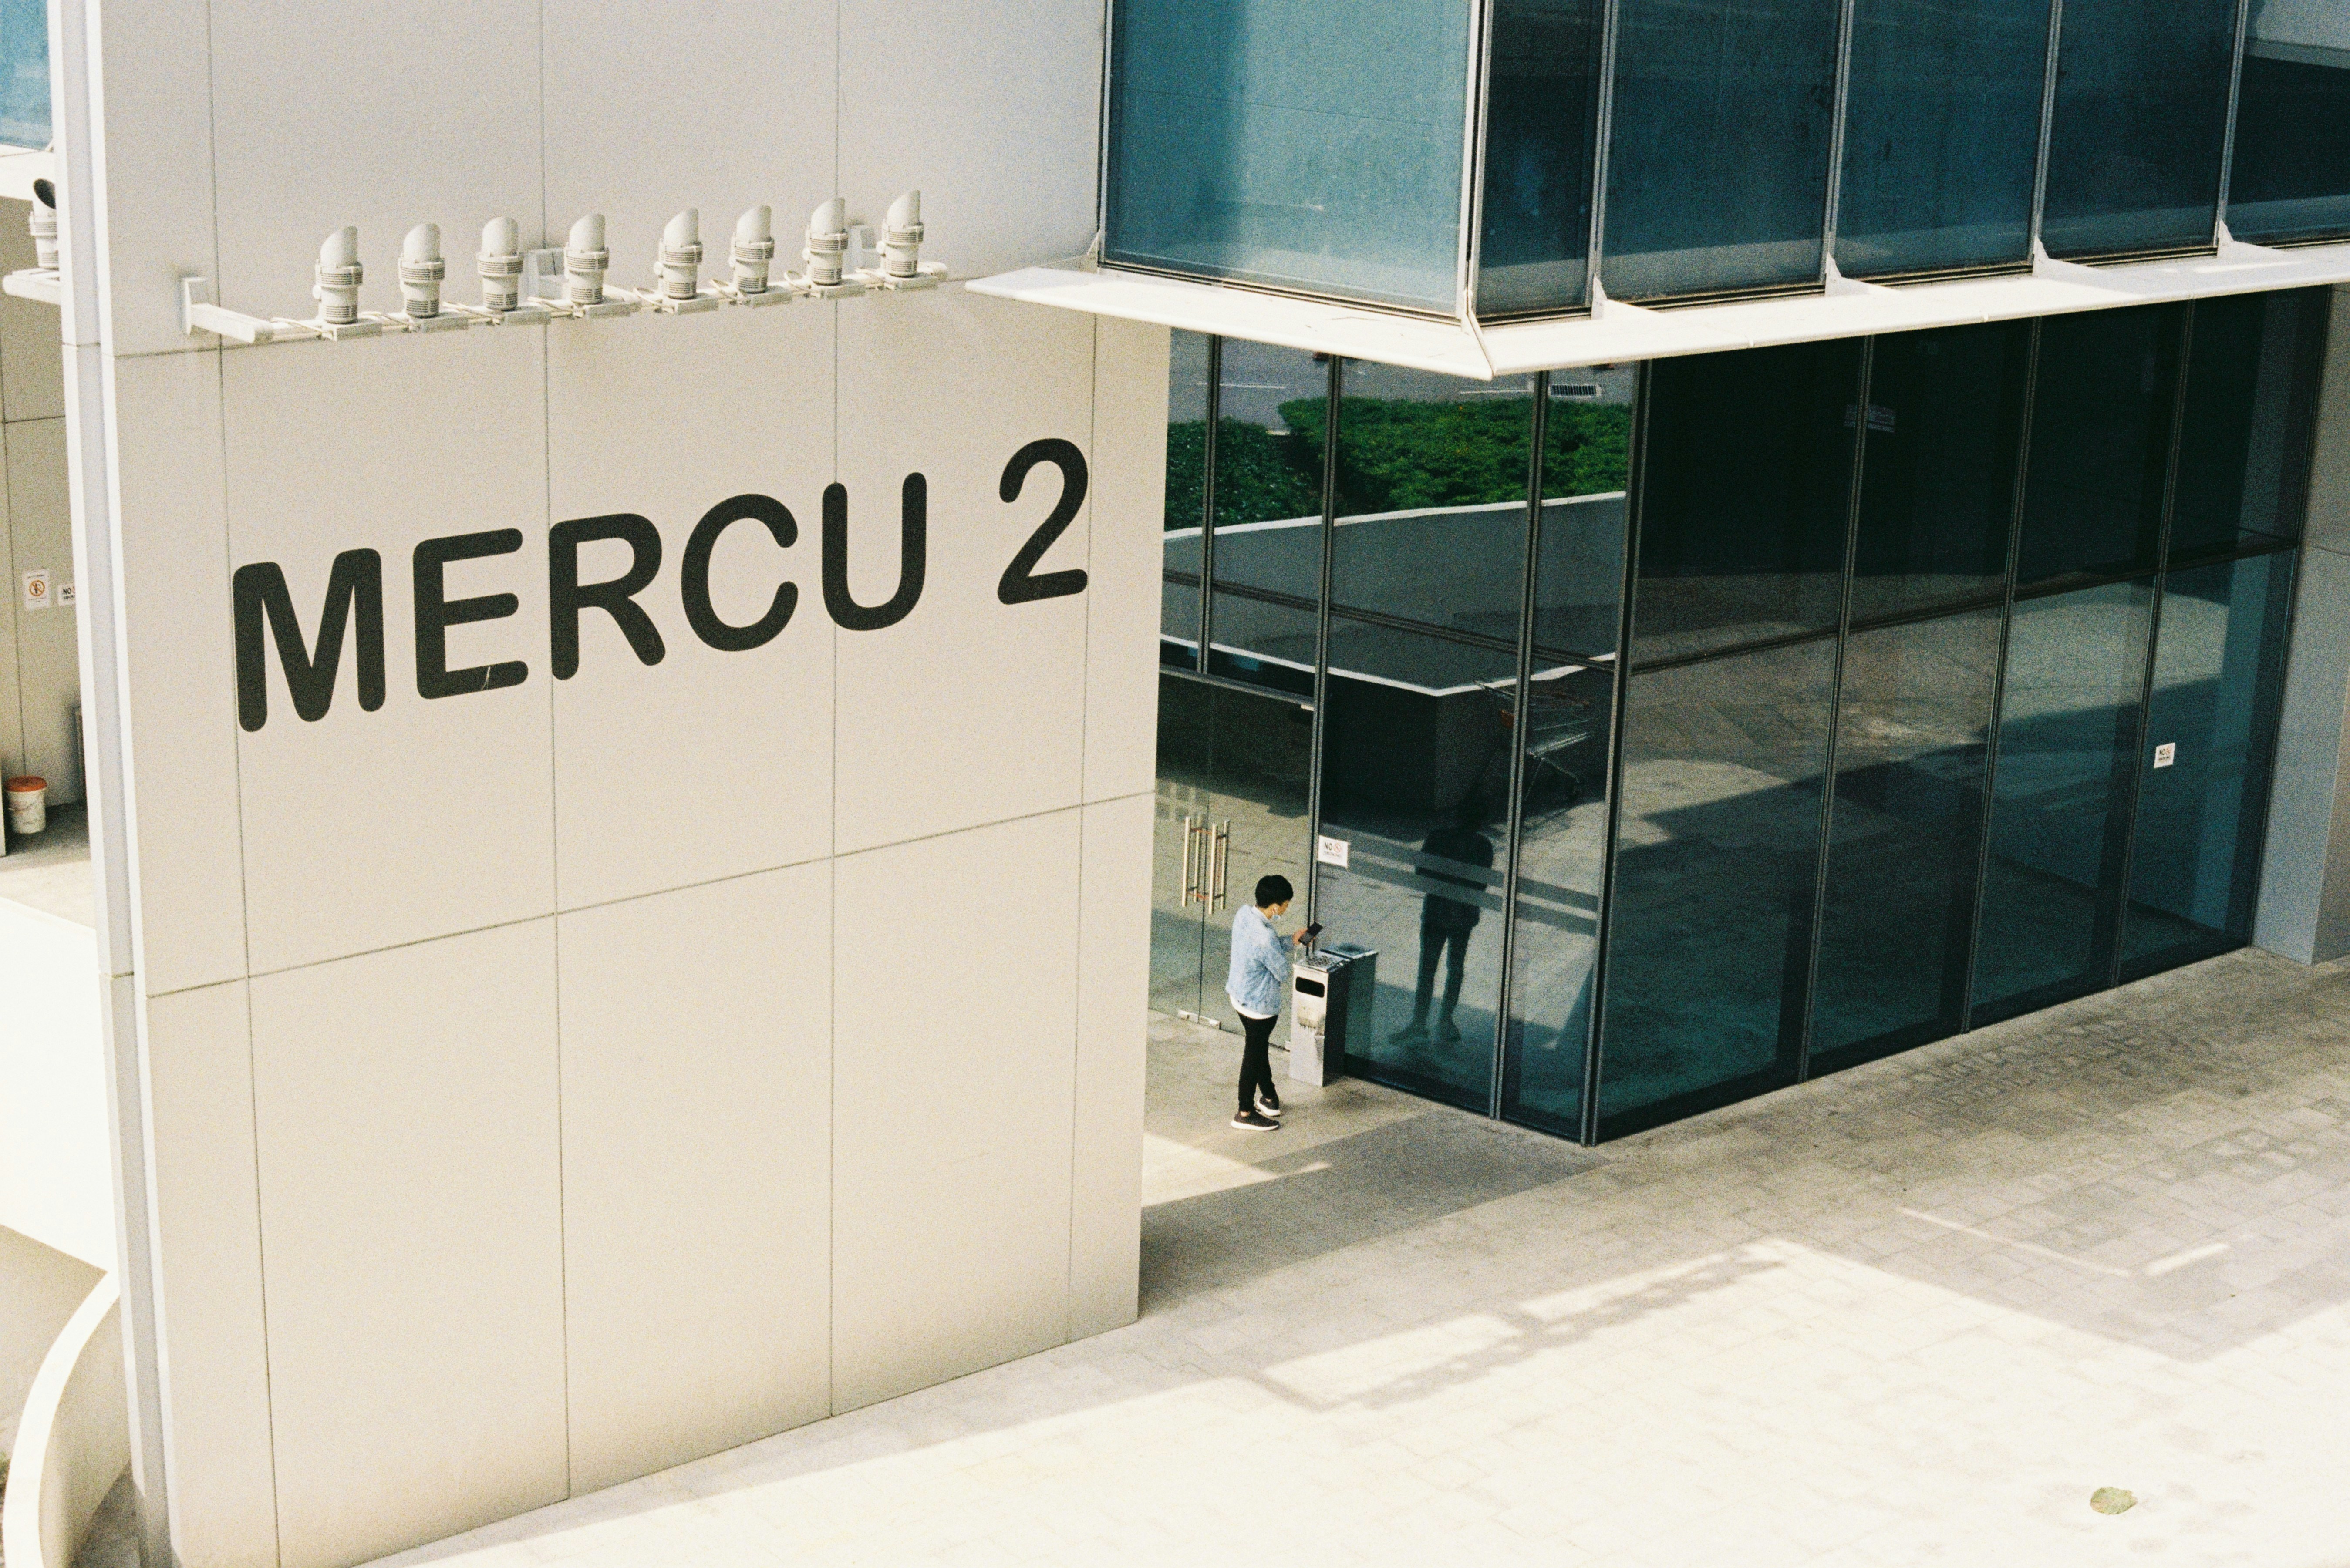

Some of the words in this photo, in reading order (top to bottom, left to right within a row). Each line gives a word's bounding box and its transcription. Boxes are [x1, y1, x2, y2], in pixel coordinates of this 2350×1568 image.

[232, 472, 927, 732] MERCU
[997, 437, 1089, 605] 2
[1324, 841, 1332, 851] NO
